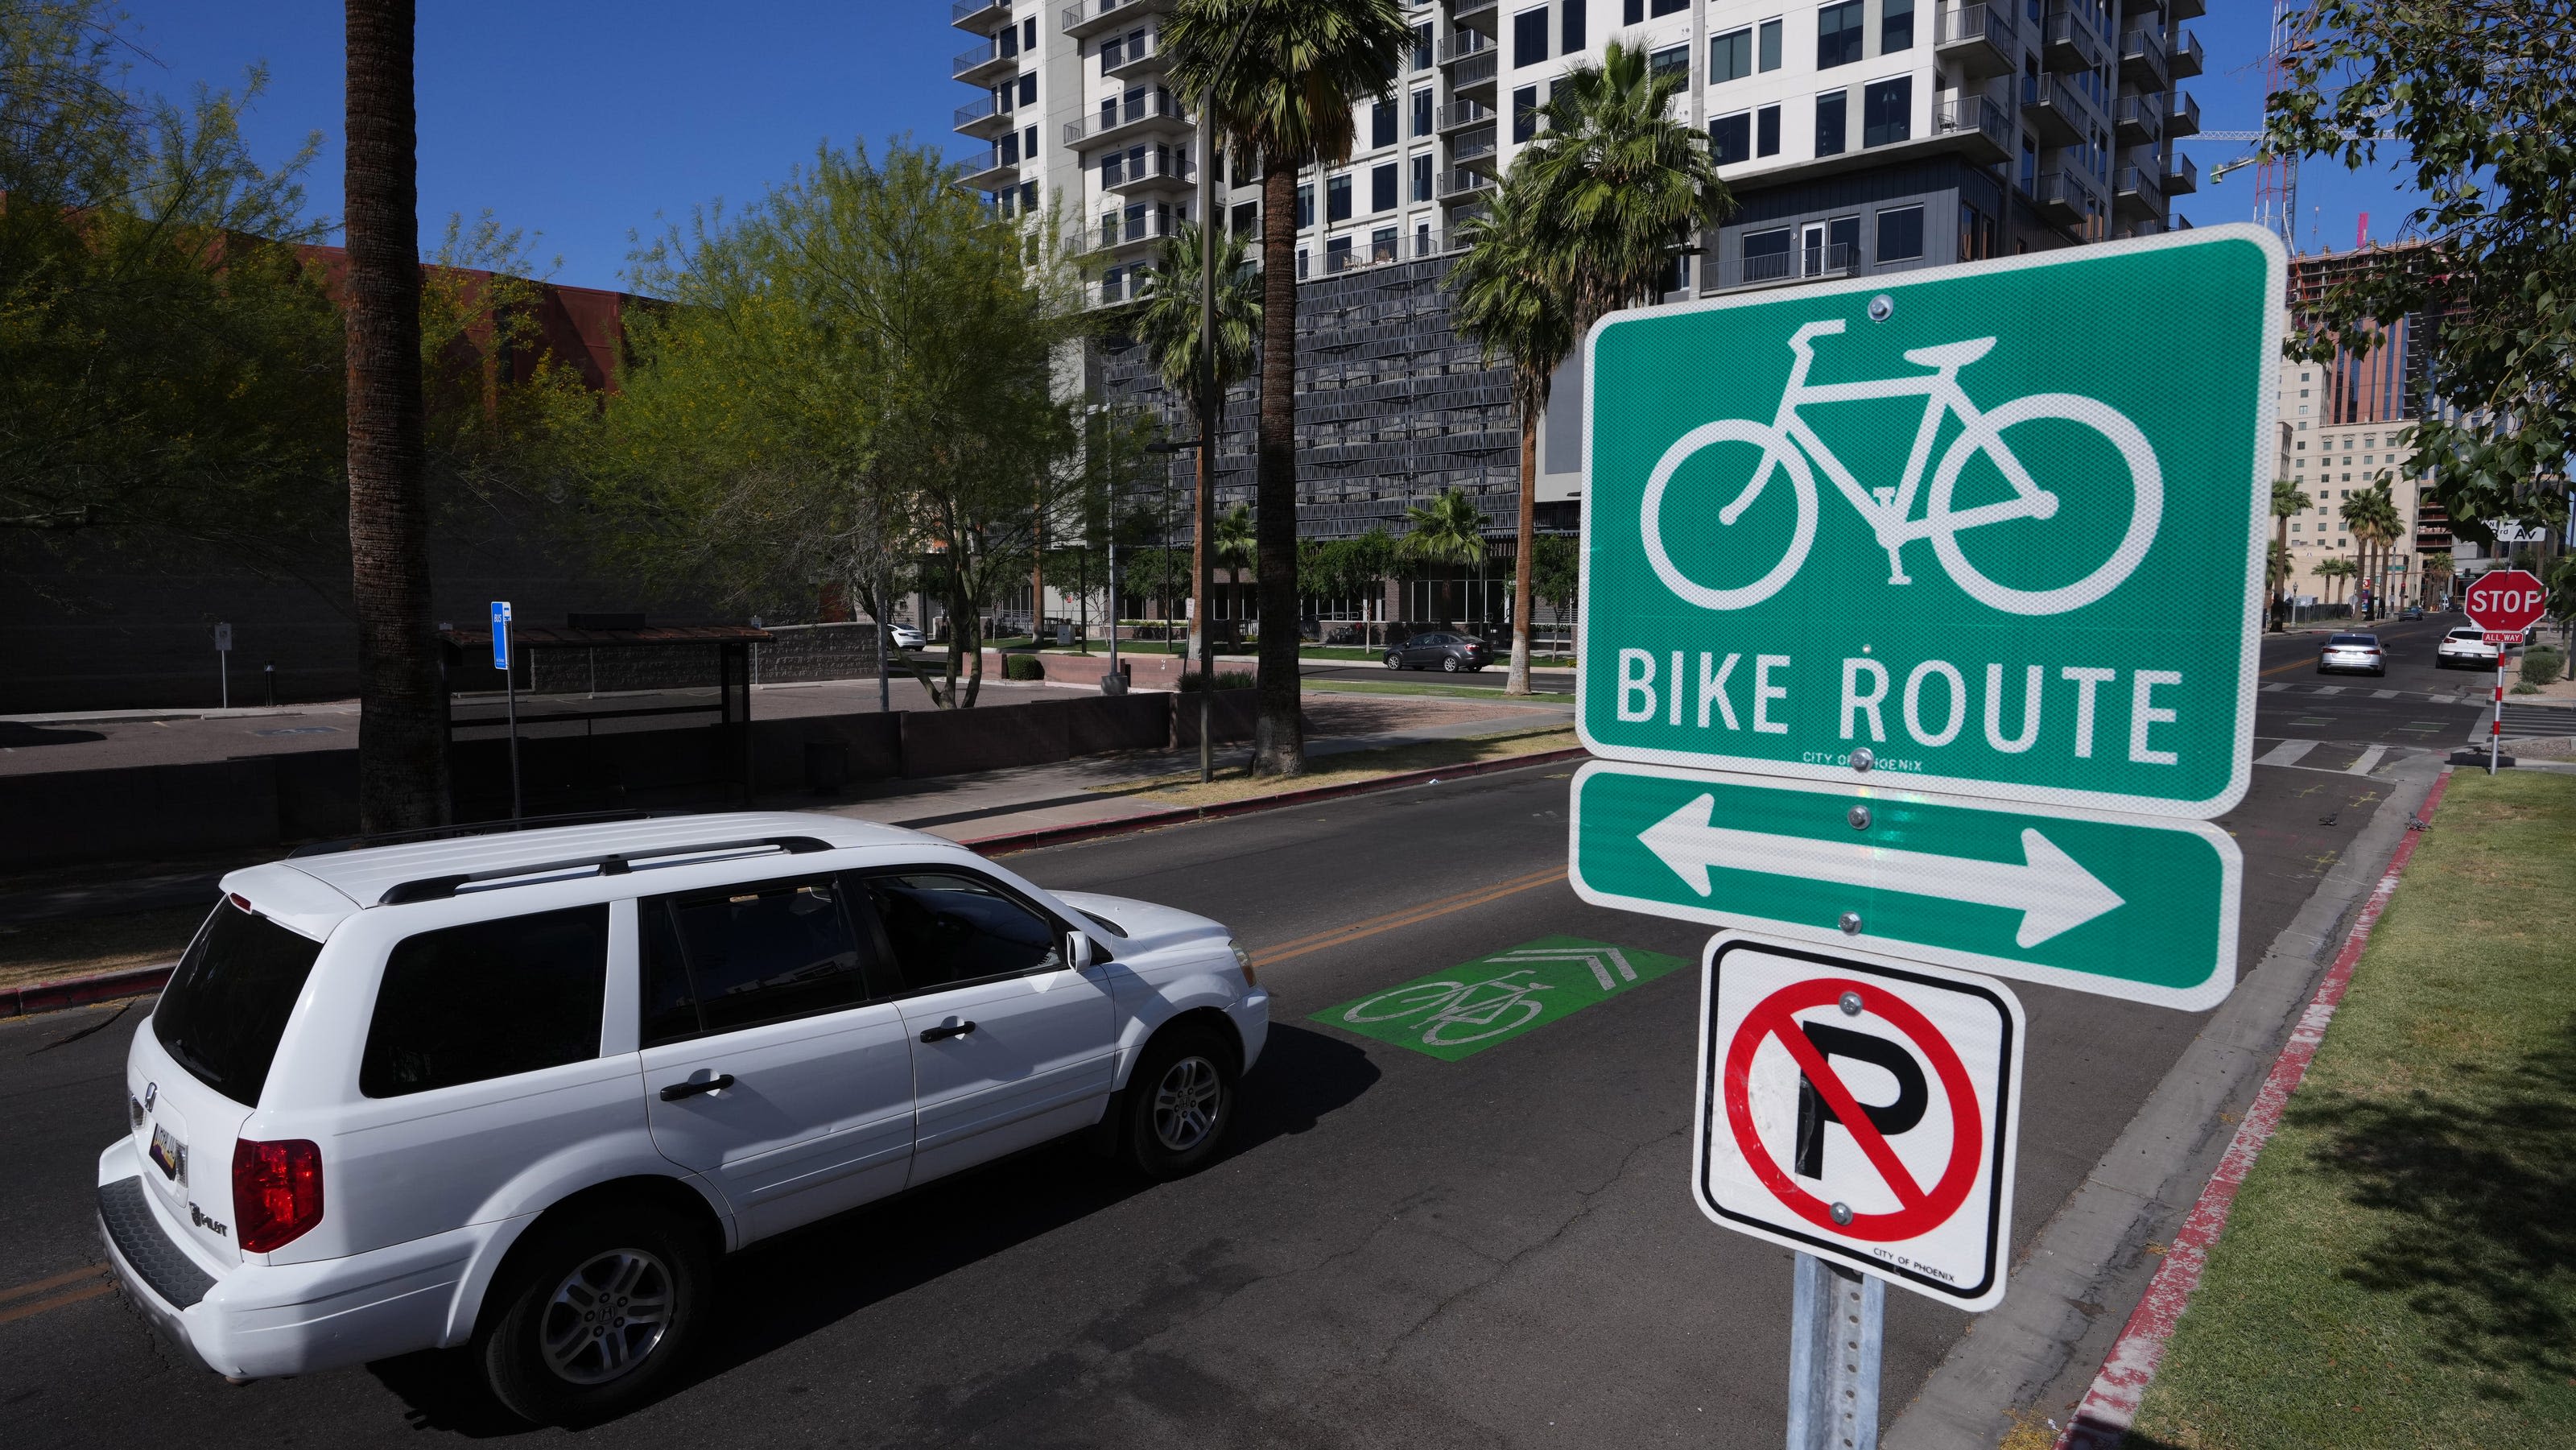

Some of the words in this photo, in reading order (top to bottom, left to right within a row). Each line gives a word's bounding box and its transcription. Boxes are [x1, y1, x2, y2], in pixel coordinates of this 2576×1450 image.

[2514, 528, 2537, 539] Av
[2471, 590, 2542, 613] STOP
[494, 613, 502, 622] BUS
[2485, 634, 2501, 642] ALL
[2504, 634, 2520, 642] WAY
[1616, 647, 1790, 734] BIKE
[1839, 657, 2183, 766] ROUTE
[1802, 751, 1833, 764] CITY
[1794, 1020, 1928, 1181] P
[200, 1212, 228, 1237] PILOT
[1873, 1247, 1894, 1260] CITY
[1897, 1256, 1910, 1266] OF
[1913, 1262, 1955, 1283] PHOENIX
